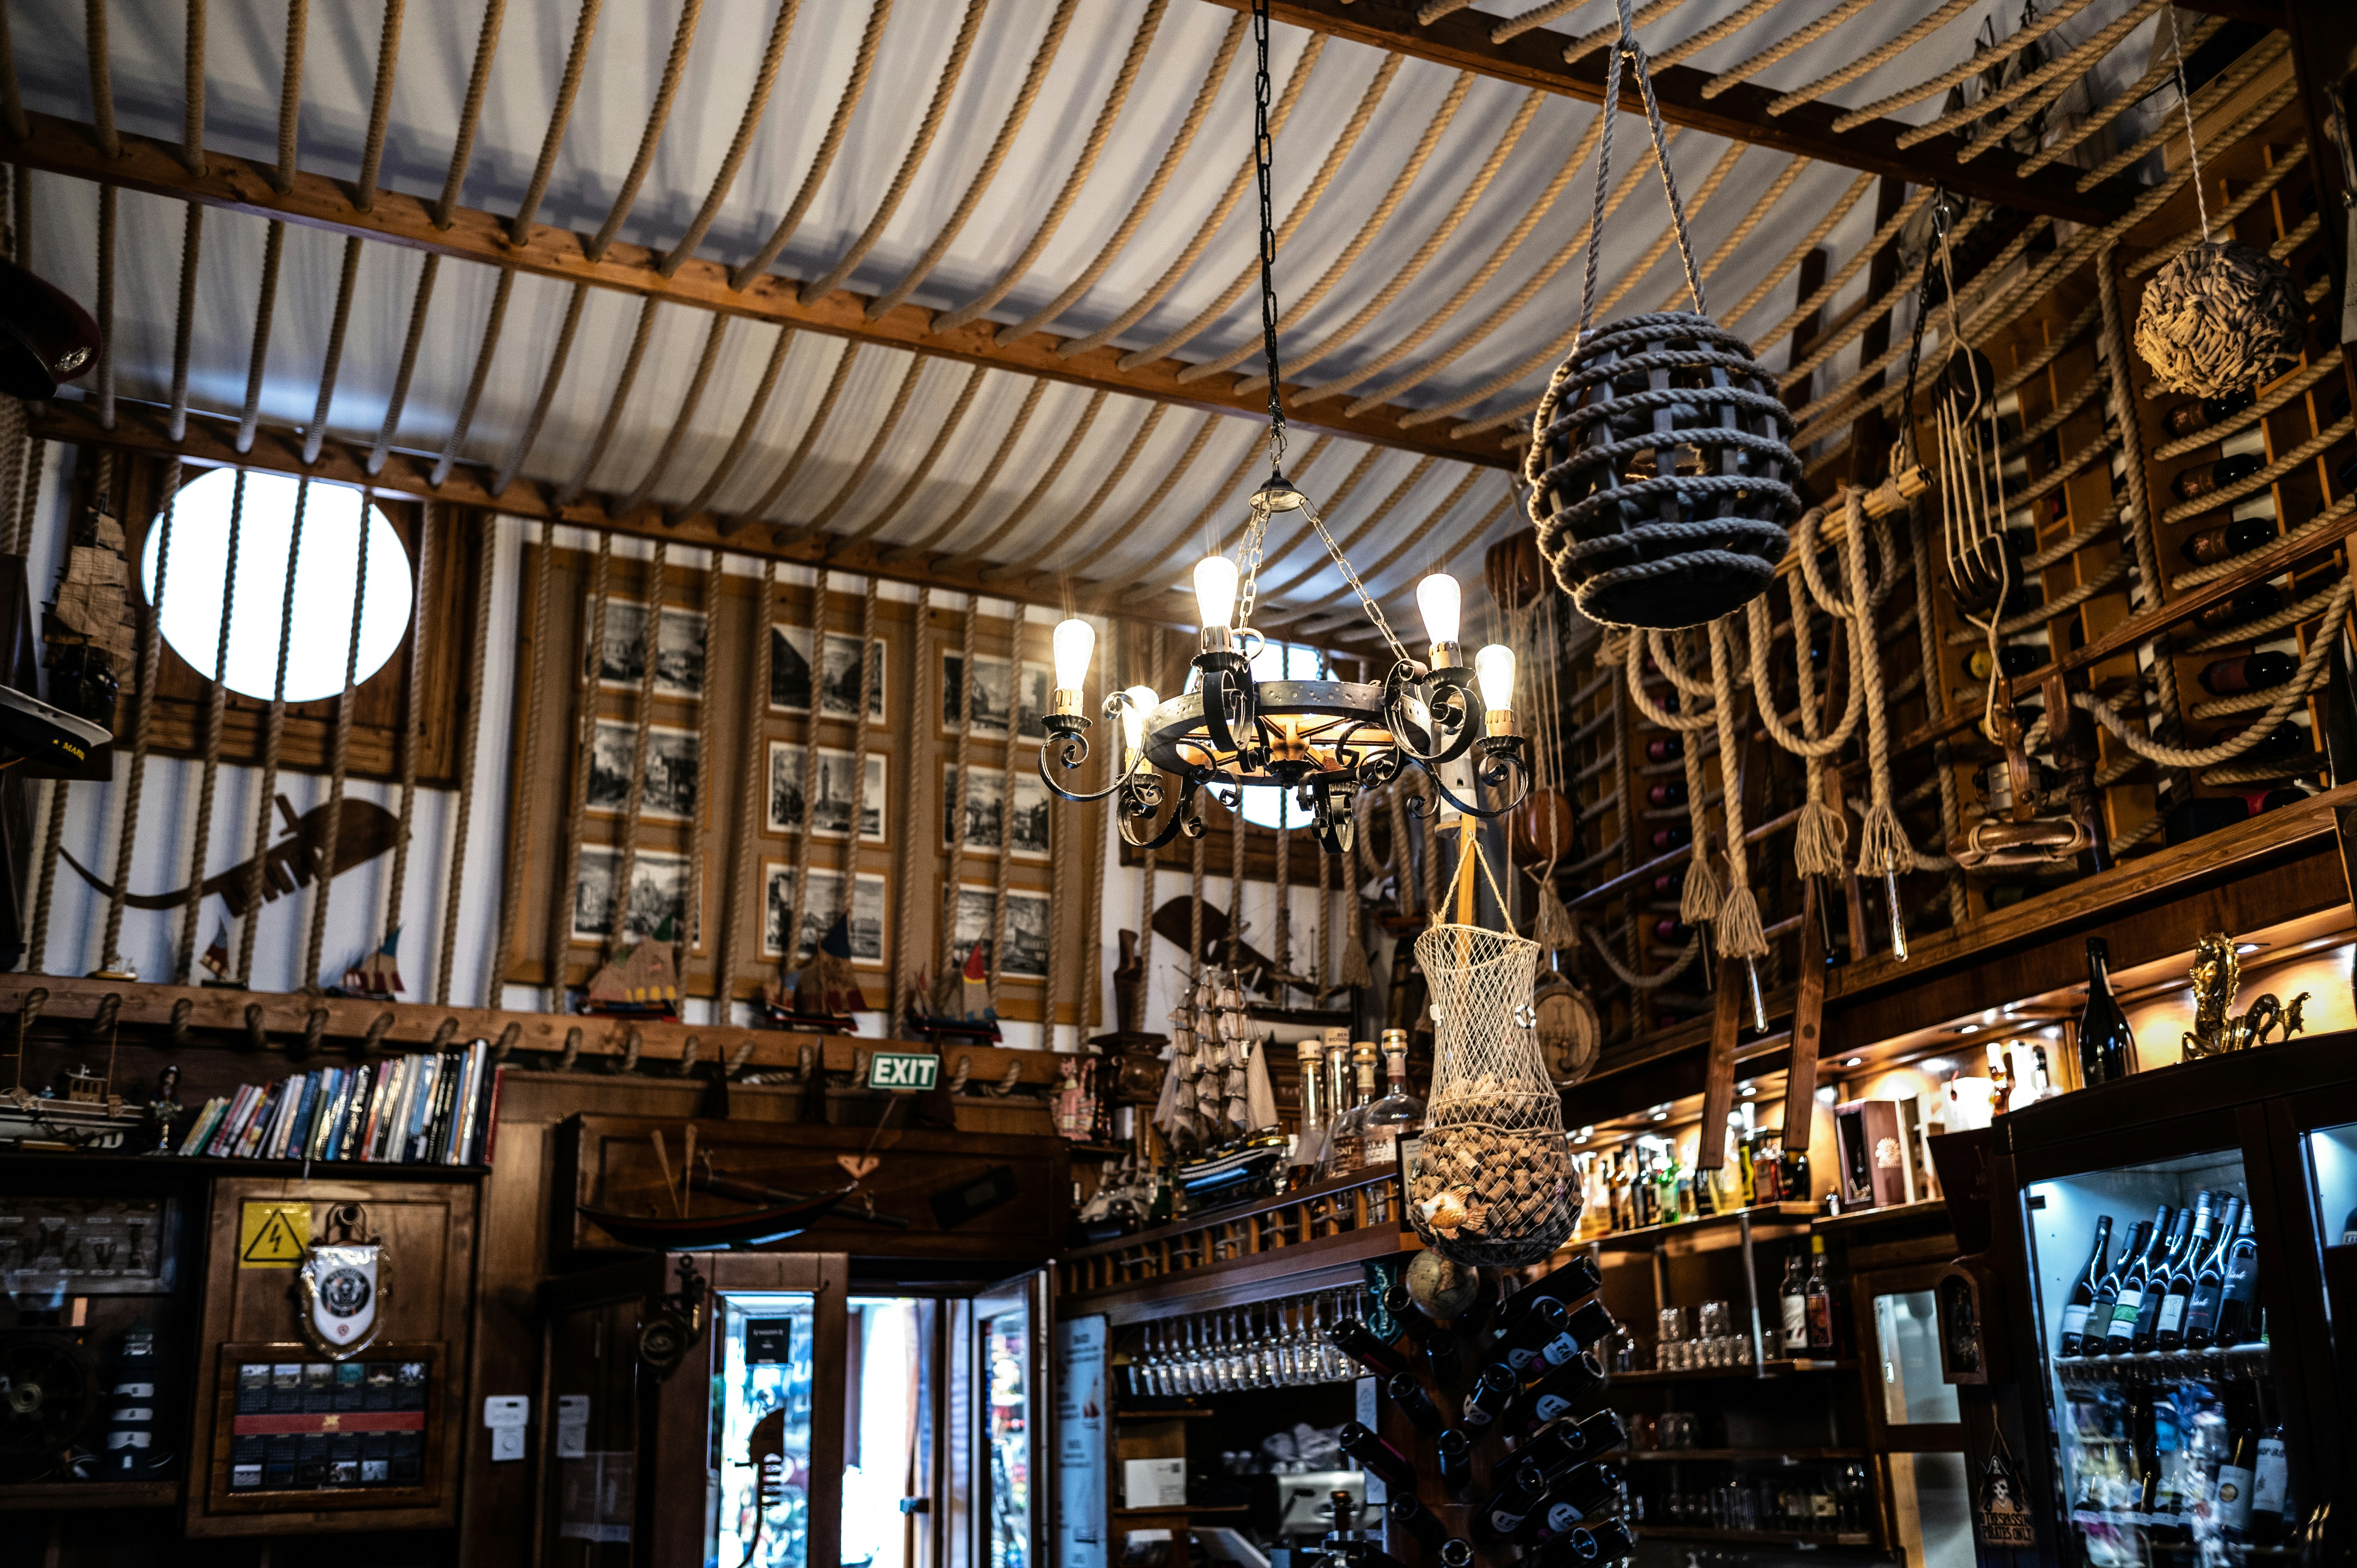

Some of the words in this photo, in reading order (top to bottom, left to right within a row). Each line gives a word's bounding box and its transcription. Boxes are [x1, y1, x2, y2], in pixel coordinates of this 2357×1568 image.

[874, 1057, 935, 1085] EXIT
[1983, 1525, 2012, 1540] PIRATES
[2012, 1527, 2031, 1541] ONLY
